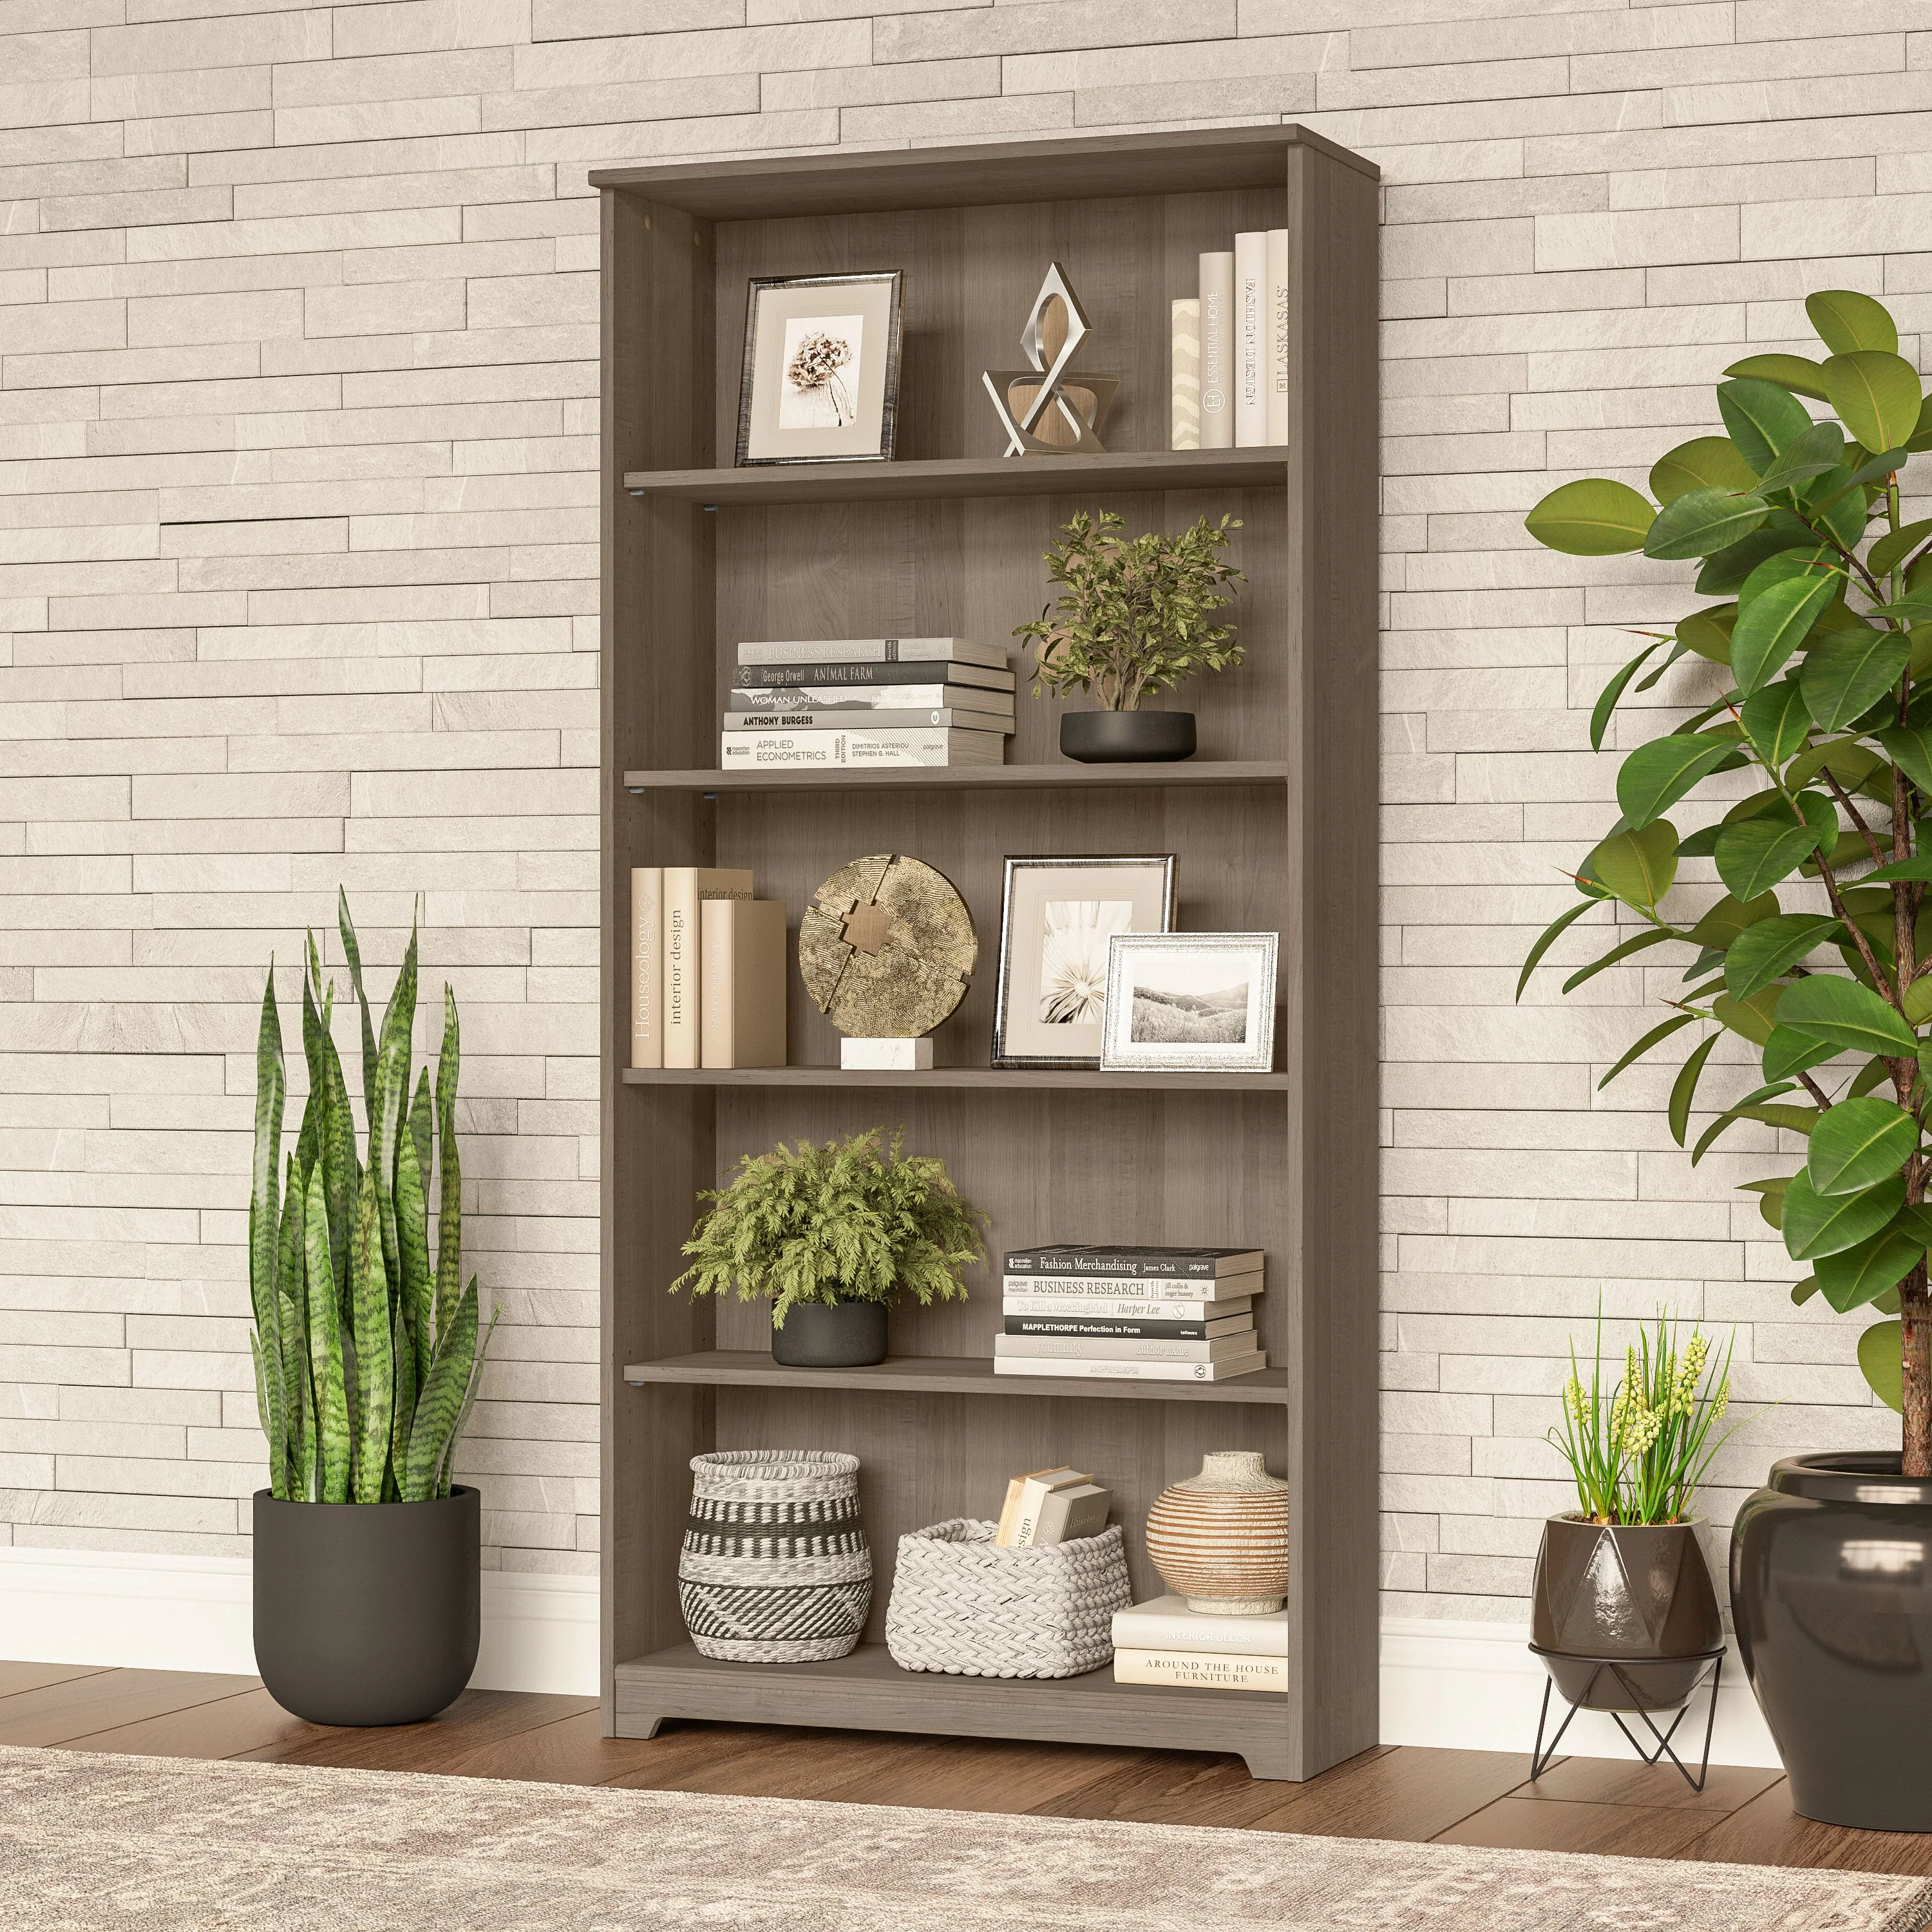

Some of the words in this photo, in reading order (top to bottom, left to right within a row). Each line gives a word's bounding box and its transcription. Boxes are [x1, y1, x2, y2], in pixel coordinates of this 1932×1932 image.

[1208, 289, 1219, 327] HOME
[1245, 279, 1255, 344] FASHION
[1276, 288, 1288, 376] LASKASAS
[1208, 328, 1219, 384] ESSENTIAL
[1245, 348, 1255, 406] DESIGN
[768, 647, 820, 659] BUSINESS
[822, 645, 881, 659] RESEARCH
[763, 670, 784, 685] George
[786, 670, 804, 682] Orwell
[850, 667, 873, 680] FARM
[751, 695, 791, 705] WOMAN
[793, 694, 848, 704] UNLEASHED
[743, 715, 779, 726] ANTHONY
[782, 715, 813, 725] BURGESS
[757, 740, 794, 749] APPLIED
[757, 751, 827, 761] ECONOMETRICS
[697, 887, 727, 900] interior
[728, 887, 753, 900] design
[670, 910, 684, 960] design
[634, 916, 654, 1039] Houseology
[670, 965, 681, 1025] interior
[1040, 1256, 1072, 1269] Fashion
[1074, 1257, 1137, 1275] Merchandising
[1142, 1263, 1159, 1273] James
[1160, 1263, 1176, 1272] Clark
[1189, 1263, 1209, 1273] palgrave
[1034, 1281, 1084, 1294] BUSINESS
[1086, 1282, 1144, 1295] RESEARCH
[1030, 1301, 1045, 1312] Kill
[1117, 1303, 1146, 1316] Harper
[1146, 1304, 1160, 1314] Lee
[1022, 1323, 1078, 1332] MAPPLETHORPE
[1035, 1340, 1084, 1356] youmility
[1136, 1344, 1164, 1356] author
[1166, 1346, 1189, 1357] name
[1018, 1518, 1031, 1546] sign
[1165, 1629, 1213, 1642] INTERIOR
[1217, 1633, 1251, 1644] DECOR
[1146, 1660, 1199, 1671] AROUND
[1205, 1663, 1230, 1672] THE
[1236, 1665, 1278, 1674] HOUSE
[1175, 1671, 1248, 1683] FURNITURE
